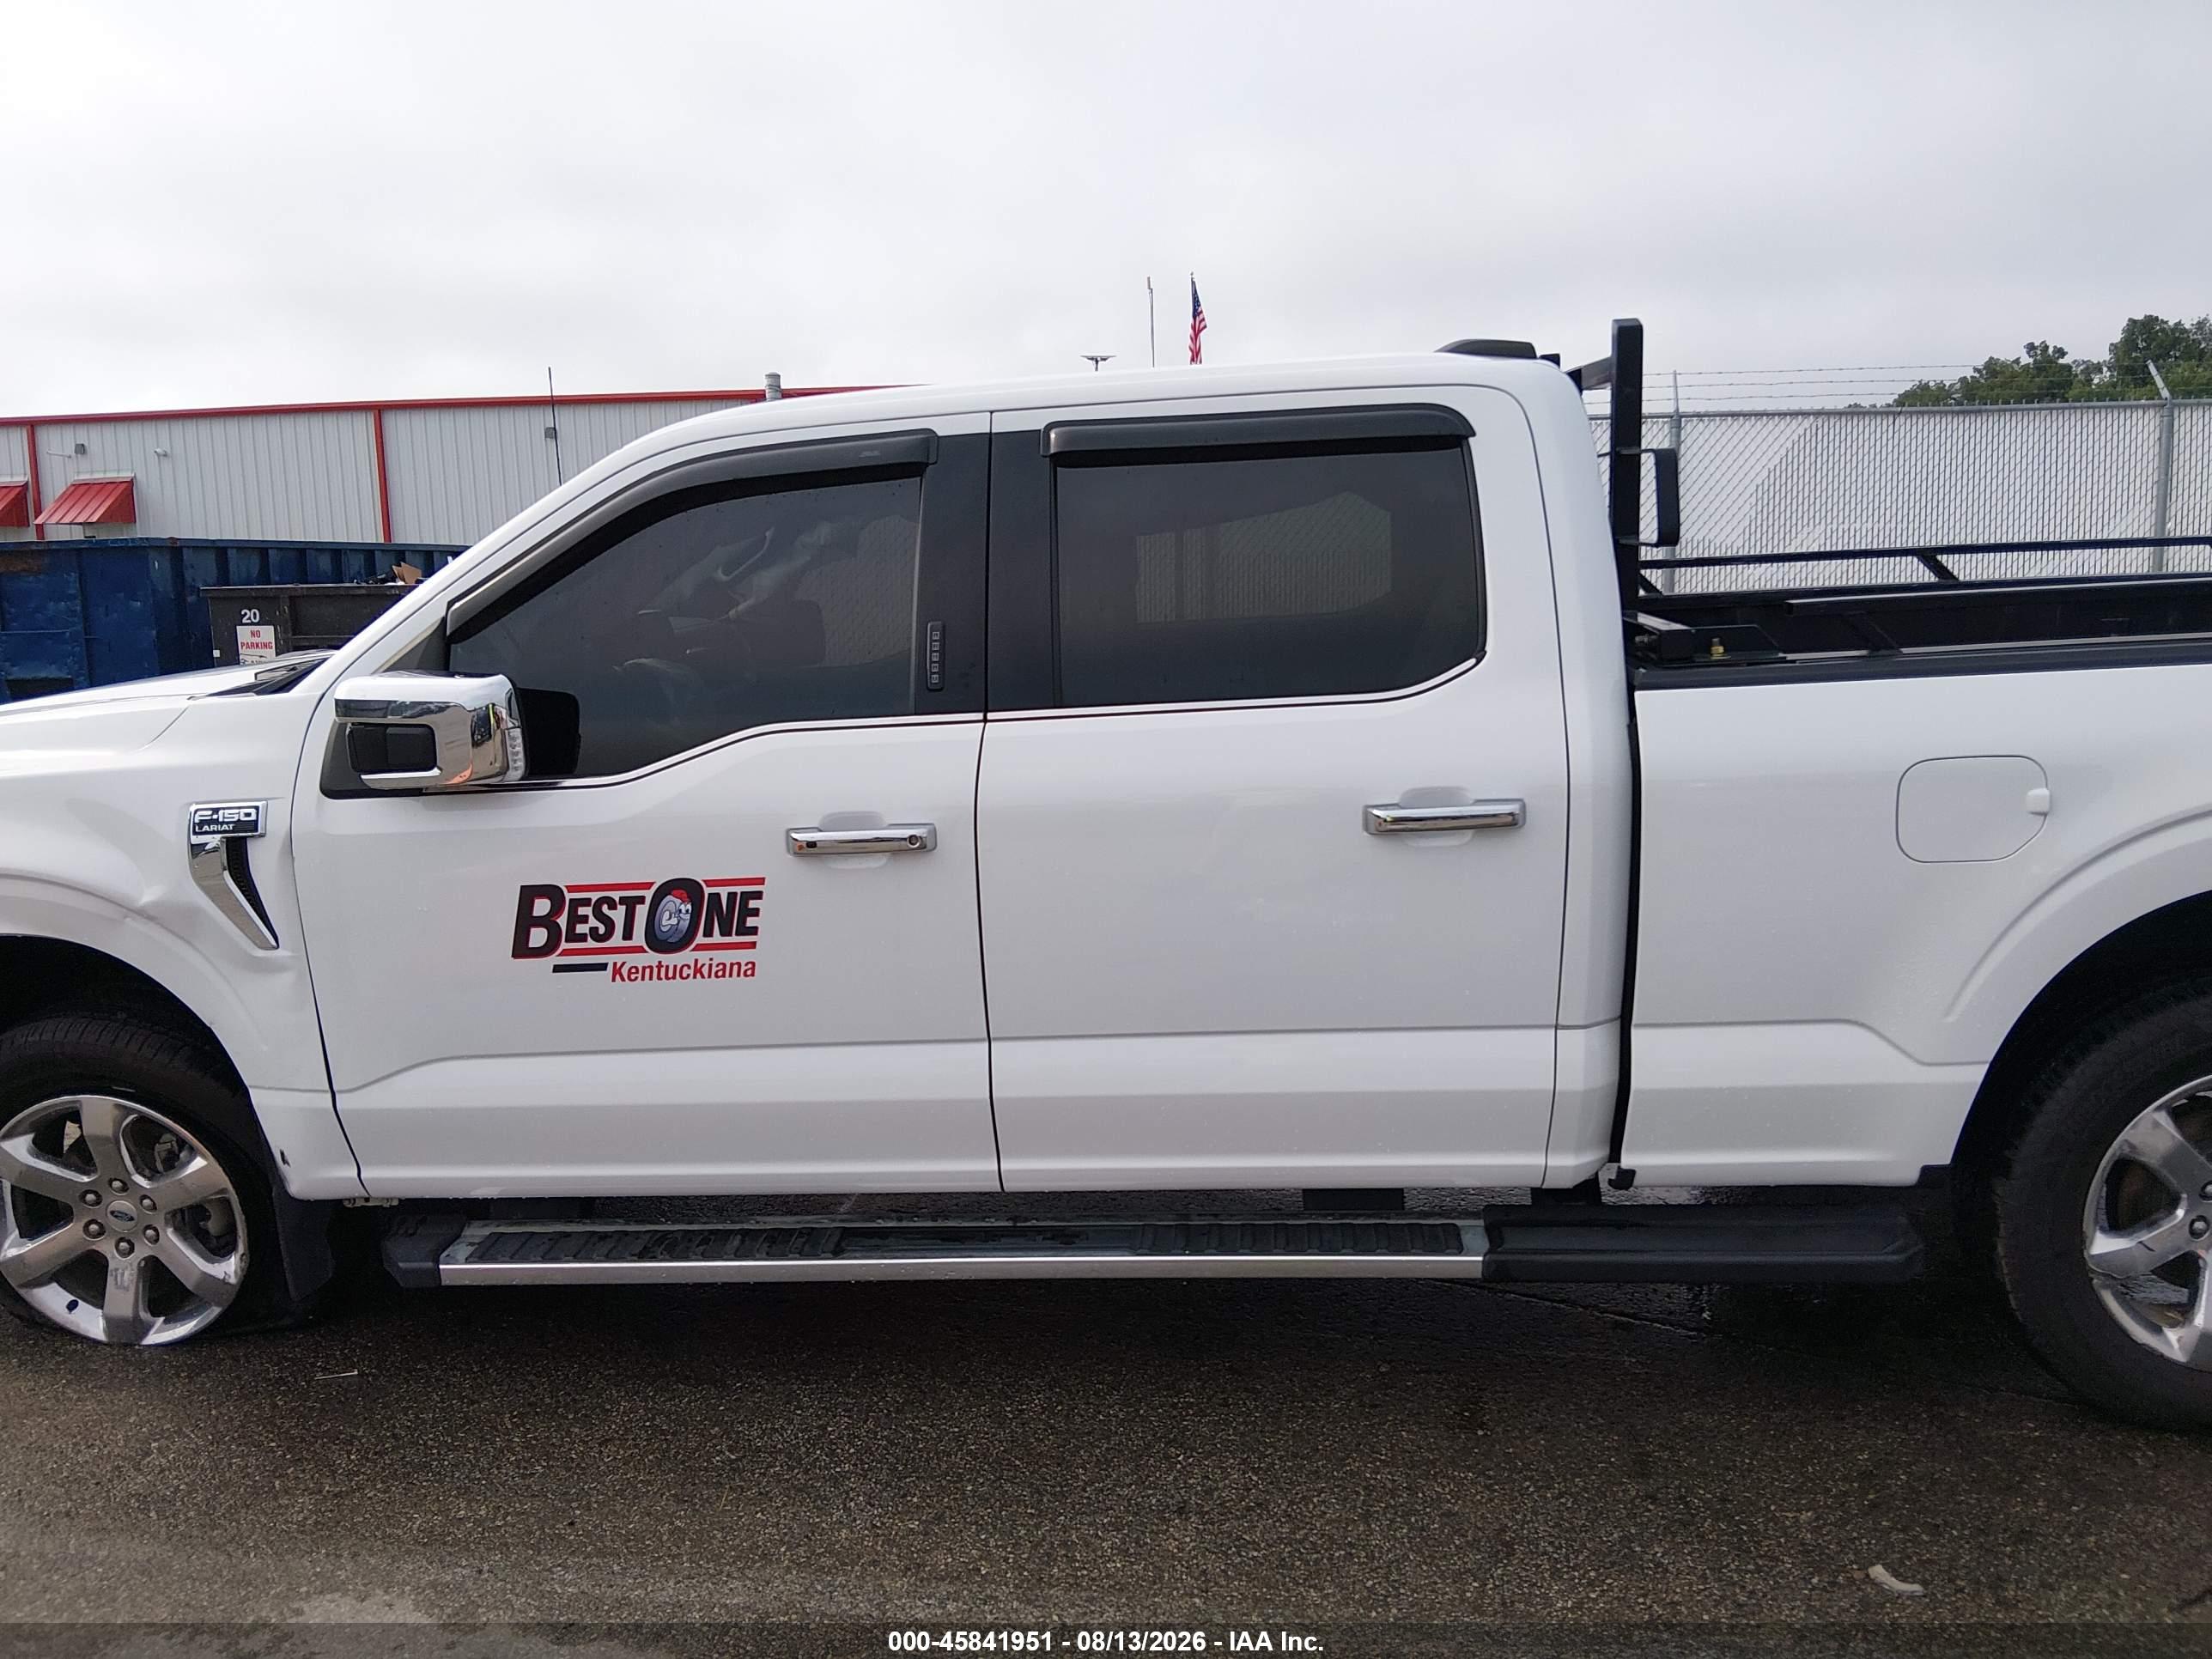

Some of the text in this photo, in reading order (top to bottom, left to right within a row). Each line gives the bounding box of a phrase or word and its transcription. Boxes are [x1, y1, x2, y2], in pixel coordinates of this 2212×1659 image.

[240, 609, 260, 623] 20
[250, 629, 261, 639] NO
[240, 641, 273, 650] PARKING
[194, 808, 258, 823] F-150
[195, 824, 235, 833] LARIAT
[611, 957, 757, 983] Kentuckiana
